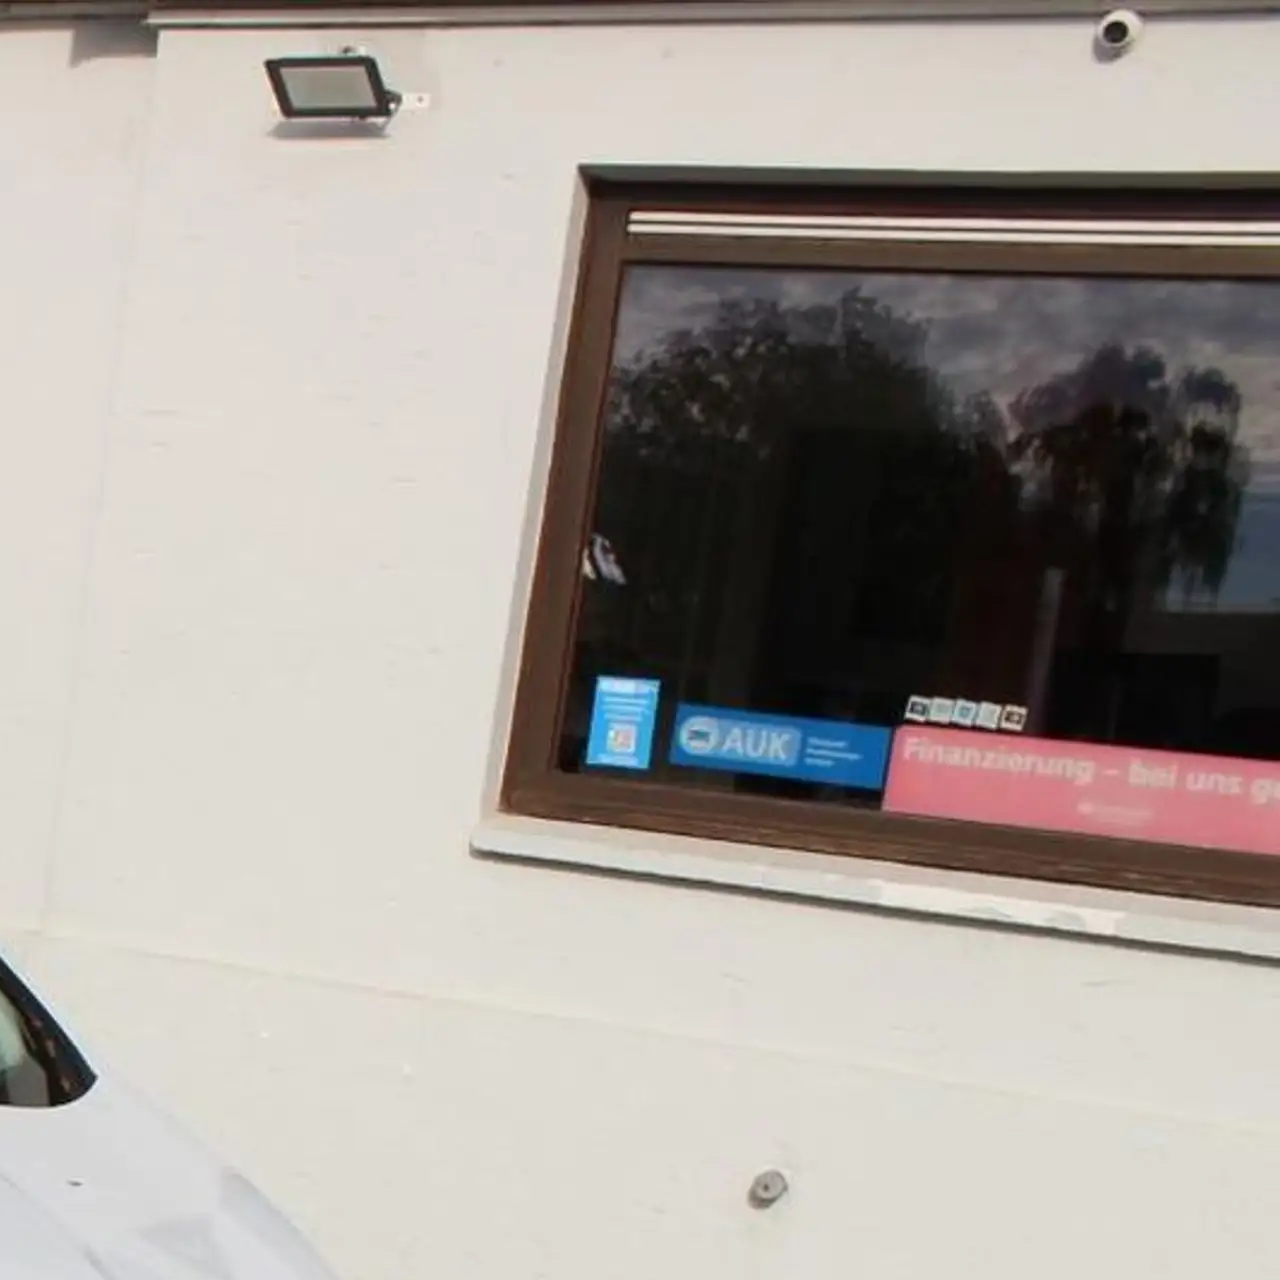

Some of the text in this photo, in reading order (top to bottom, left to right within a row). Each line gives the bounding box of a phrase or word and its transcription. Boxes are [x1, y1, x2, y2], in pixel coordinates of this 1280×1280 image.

[723, 727, 792, 761] AUK
[902, 737, 1096, 784] Finanzierung
[1128, 757, 1177, 790] bei
[1187, 768, 1244, 795] uns
